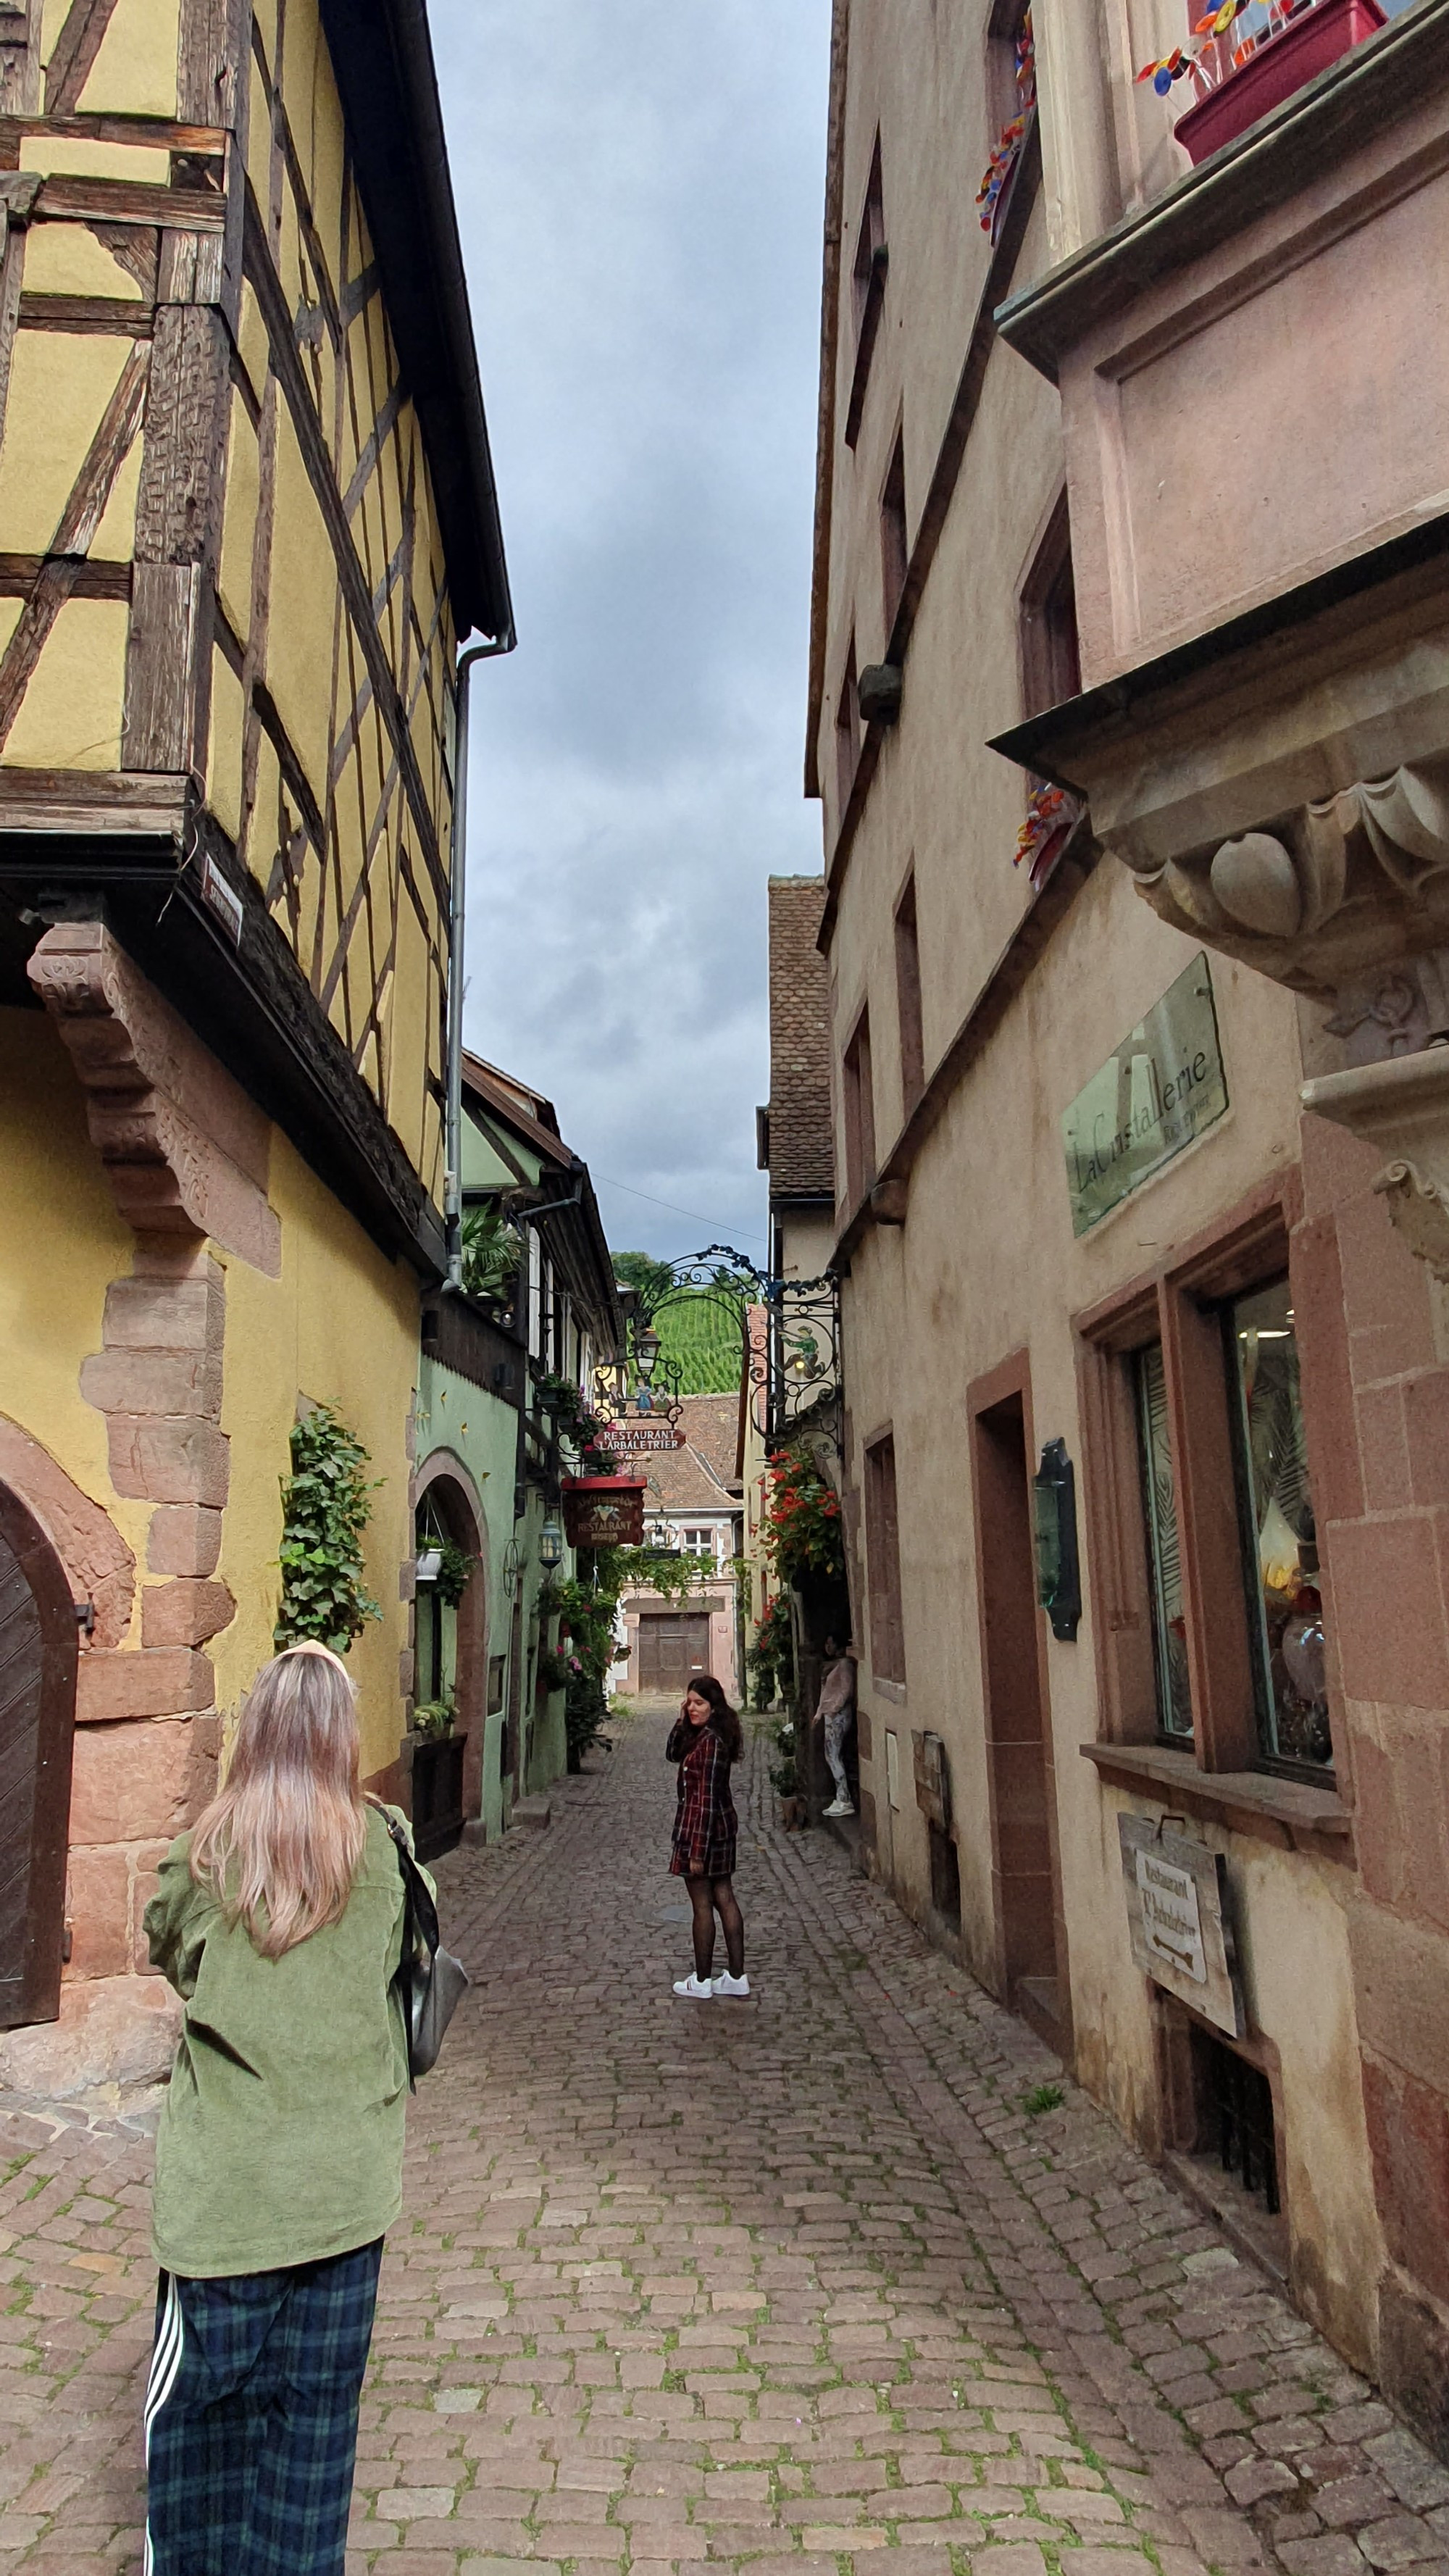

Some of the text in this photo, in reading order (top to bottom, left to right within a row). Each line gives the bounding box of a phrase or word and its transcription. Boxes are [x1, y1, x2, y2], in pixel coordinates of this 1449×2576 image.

[604, 1430, 675, 1441] RESTAURANT
[598, 1440, 678, 1450] L'ARBALETRIER
[577, 1521, 632, 1532] RESTAURANT
